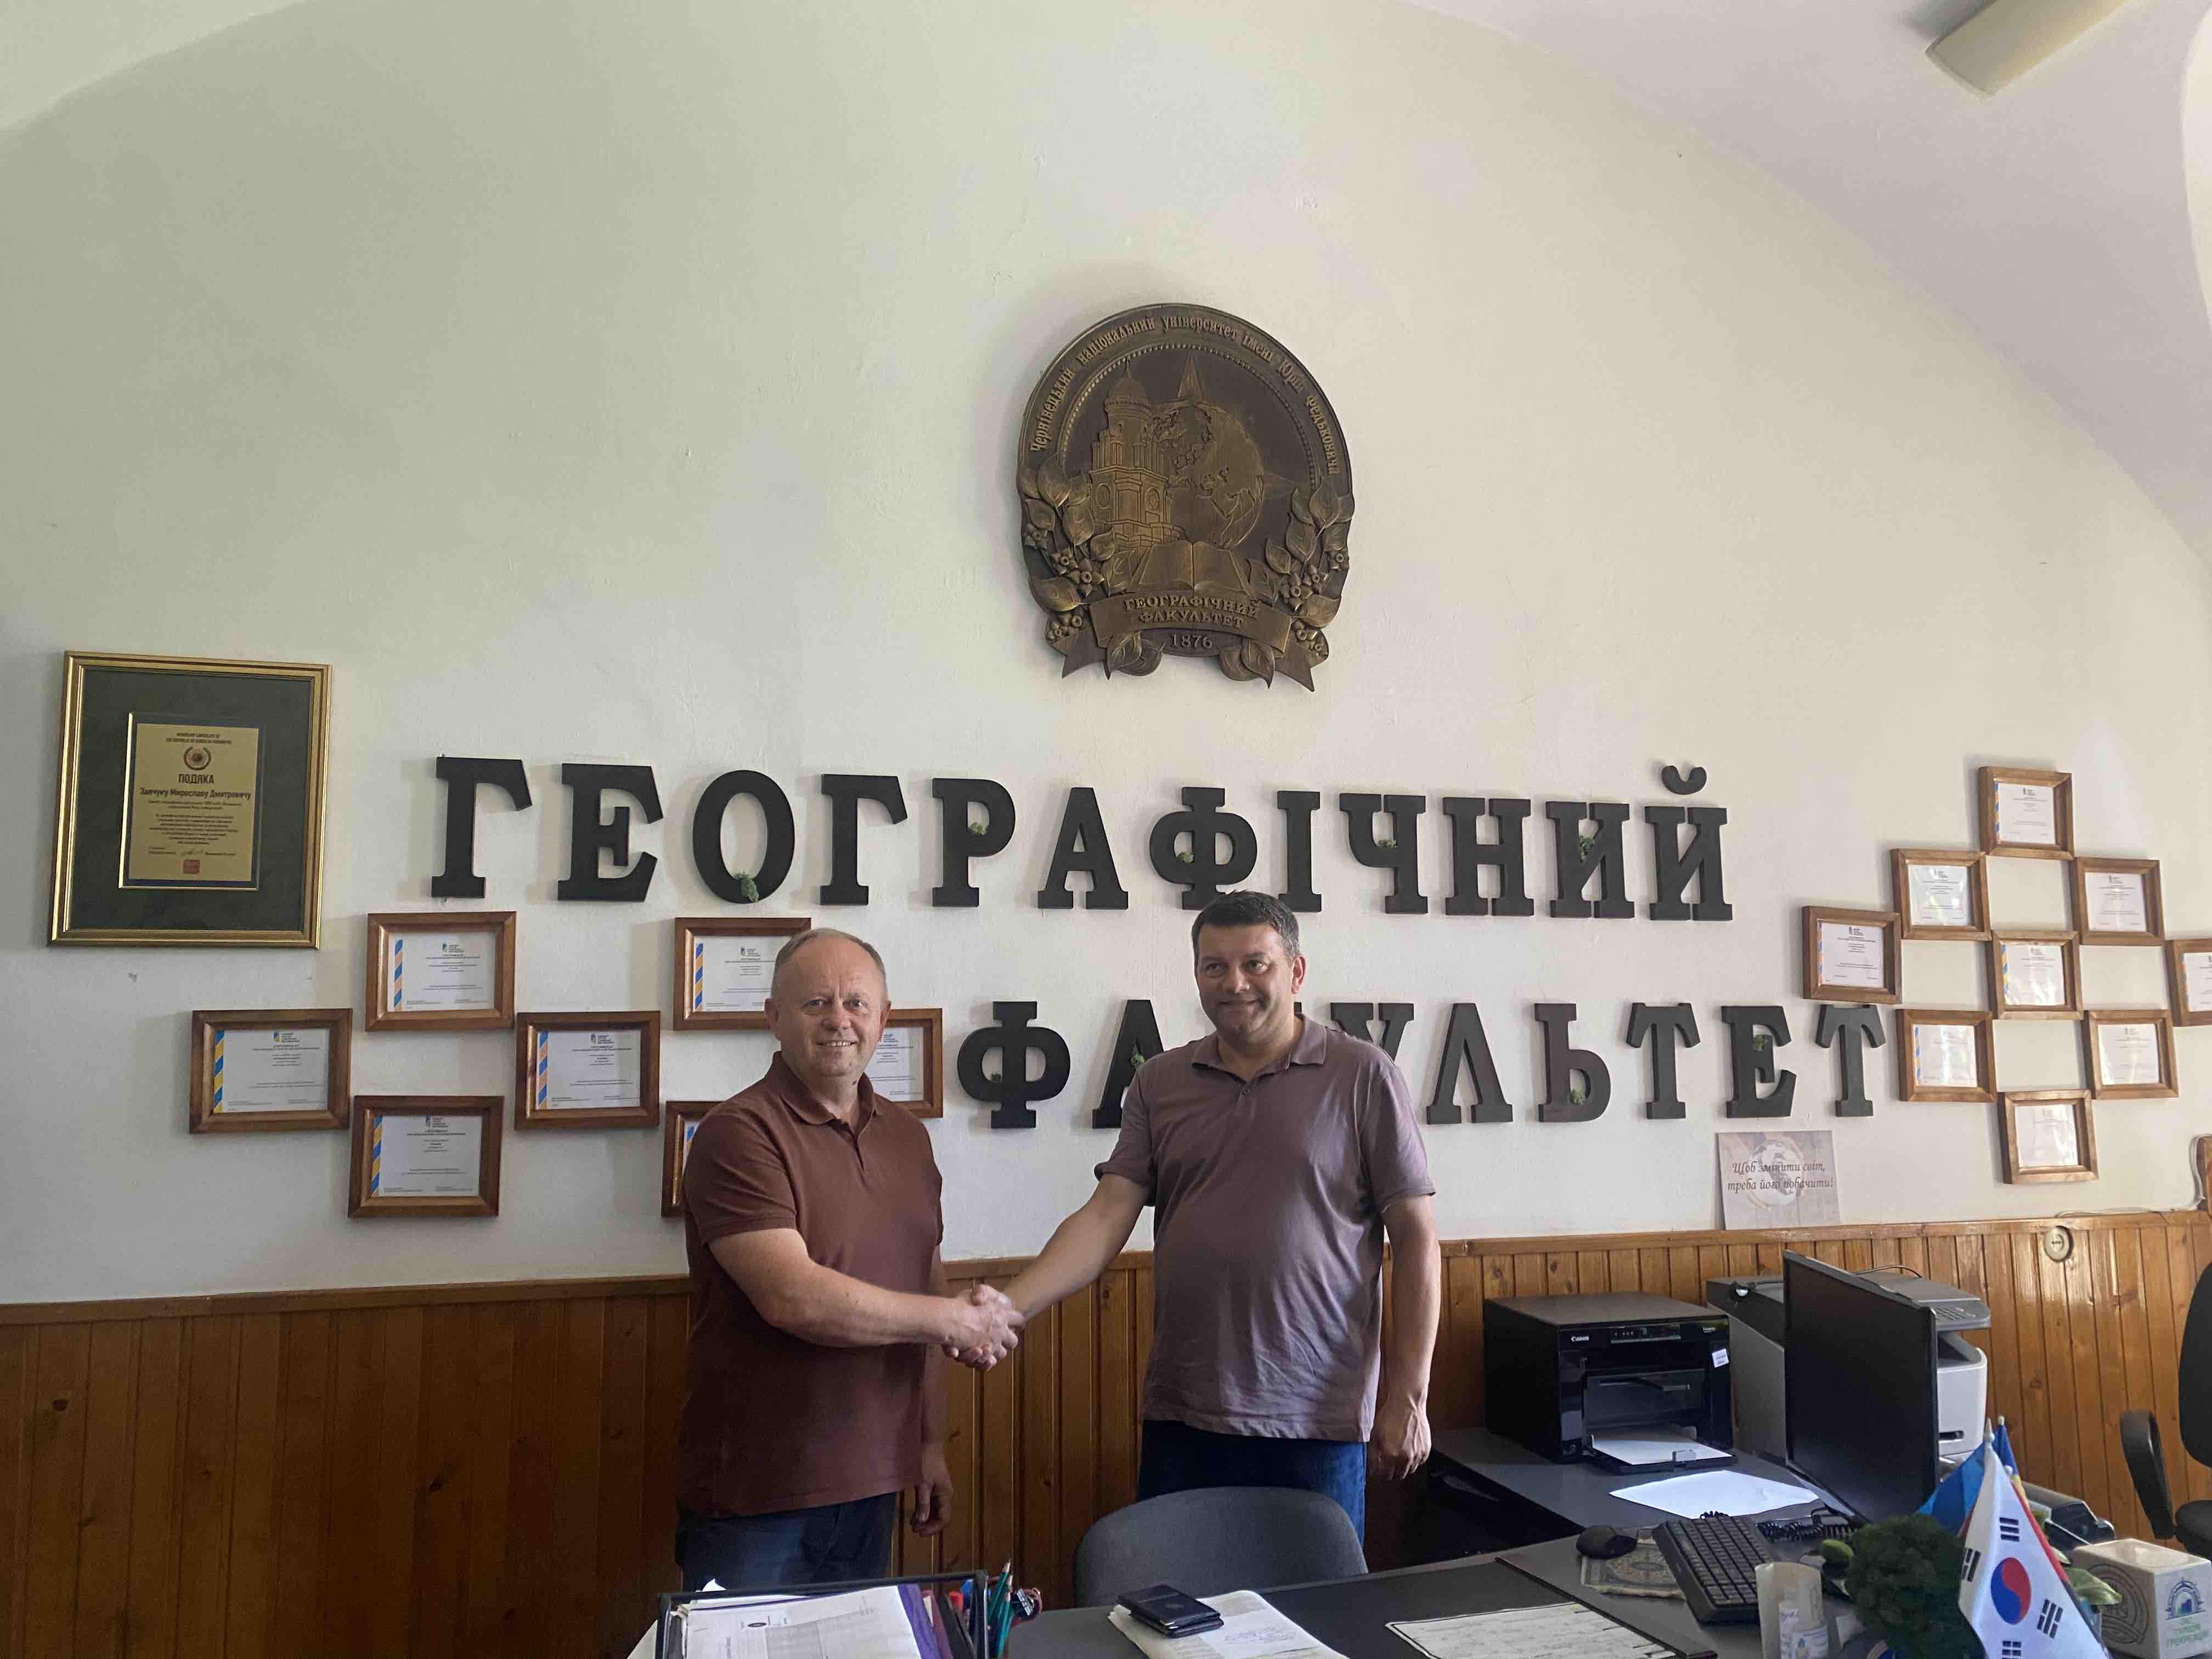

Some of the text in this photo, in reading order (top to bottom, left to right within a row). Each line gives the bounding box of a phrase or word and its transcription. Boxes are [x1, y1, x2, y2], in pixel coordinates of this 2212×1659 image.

[1029, 366, 1075, 452] Чернівецький
[1076, 314, 1155, 366] національний
[1161, 315, 1238, 342] університет
[1242, 332, 1274, 363] імені
[1124, 595, 1261, 619] ГЕОГРАФІЧНИЙ
[1139, 610, 1244, 628] ФАКУЛЬТЕТ
[1170, 632, 1213, 650] 1876
[178, 774, 214, 784] ПОДЯКА
[432, 757, 1733, 921] ГЕОГРАФІЧНИЙ
[1733, 1161, 1757, 1175] Щоб
[1758, 1163, 1801, 1172] змінити
[1728, 1176, 1833, 1193] треба його побачити!
